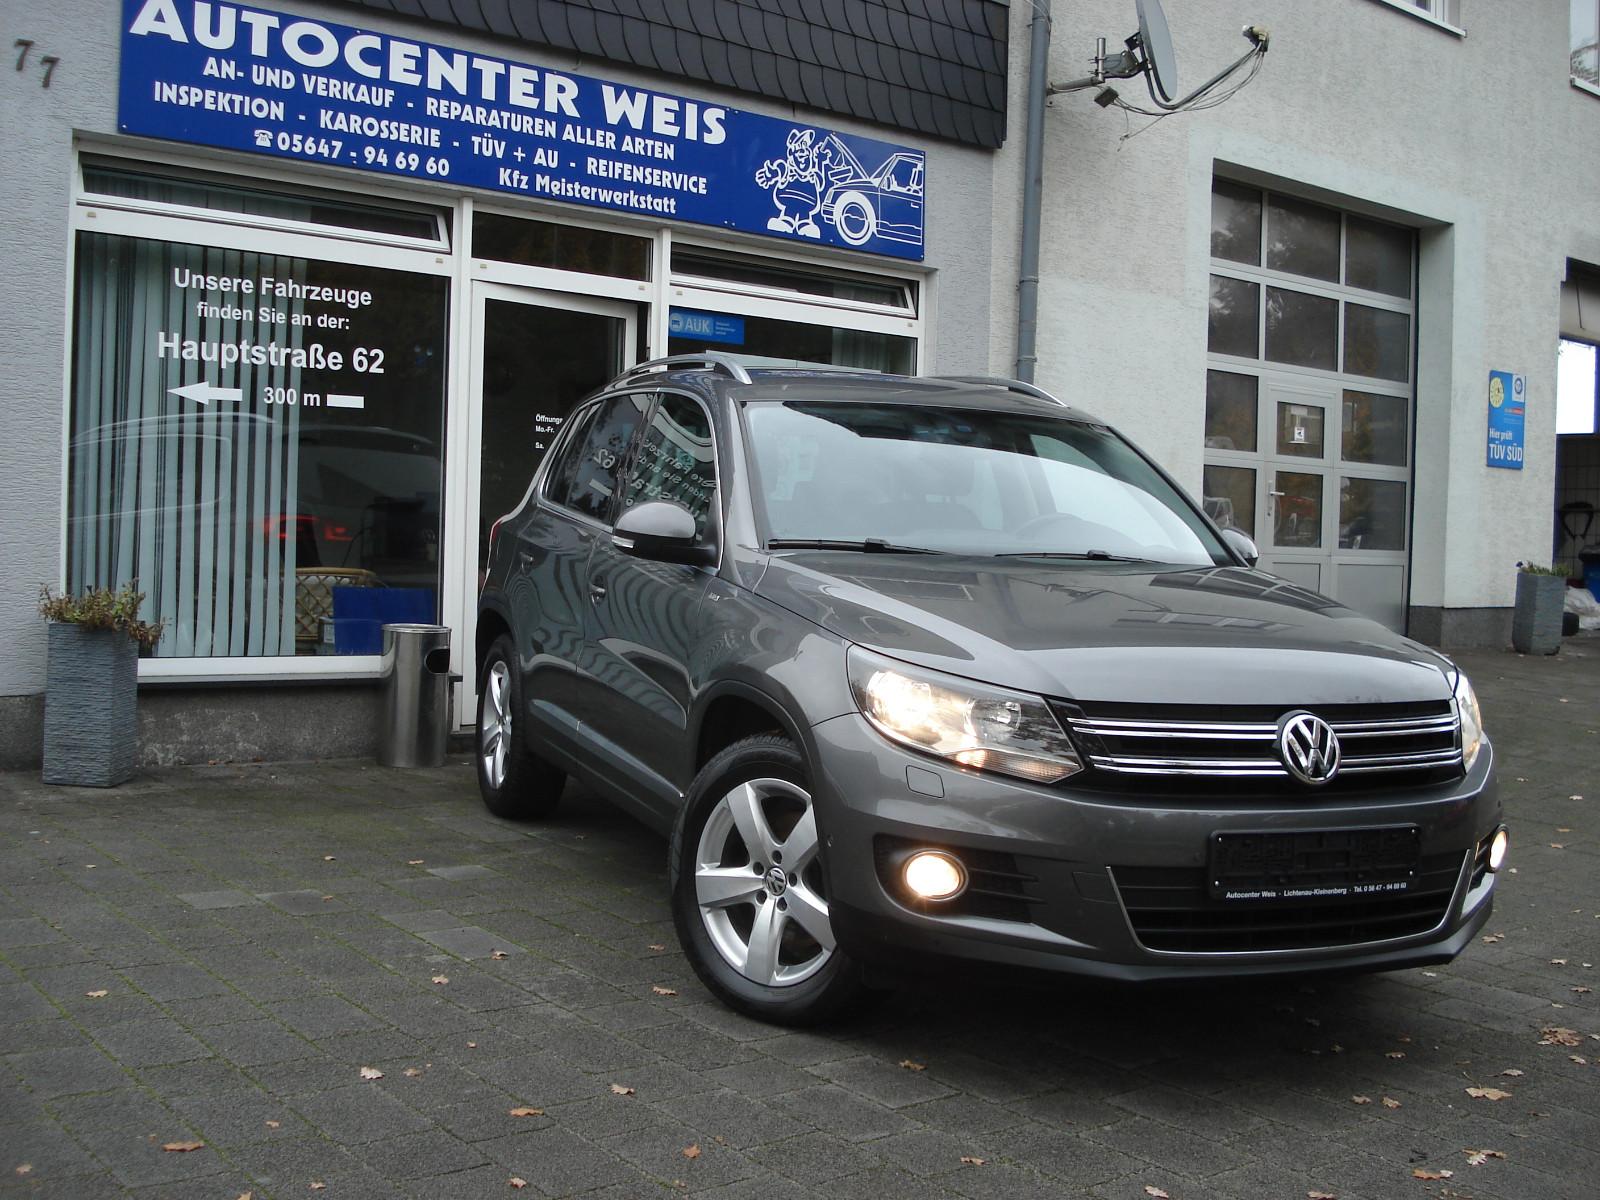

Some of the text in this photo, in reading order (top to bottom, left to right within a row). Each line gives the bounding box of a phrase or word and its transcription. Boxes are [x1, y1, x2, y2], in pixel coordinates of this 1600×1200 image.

[129, 0, 727, 146] AUTOCENTER WEIS
[203, 57, 244, 80] AN-
[252, 64, 296, 90] UND
[302, 74, 395, 108] VERKAUF
[426, 97, 557, 139] REPARATUREN
[562, 124, 616, 151] ALLER
[621, 136, 675, 161] ARTEN
[154, 81, 285, 121] INSPEKTION
[320, 109, 441, 148] KAROSSERIE
[471, 133, 506, 159] TÜV
[533, 148, 559, 169] AU
[587, 156, 707, 195] REIFENSERVICE
[277, 132, 343, 159] 05647
[364, 146, 388, 167] 94
[395, 151, 419, 171] 69
[425, 157, 450, 177] 60
[499, 167, 677, 215] Kfz Meisterwerkstatt
[174, 268, 372, 309] Unsere Fahrzeuge
[197, 302, 350, 330] finden Sie an der:
[158, 331, 385, 374] Hauptstraße 62
[263, 386, 321, 407] 300 m
[1488, 441, 1523, 462] TÜV SÜD
